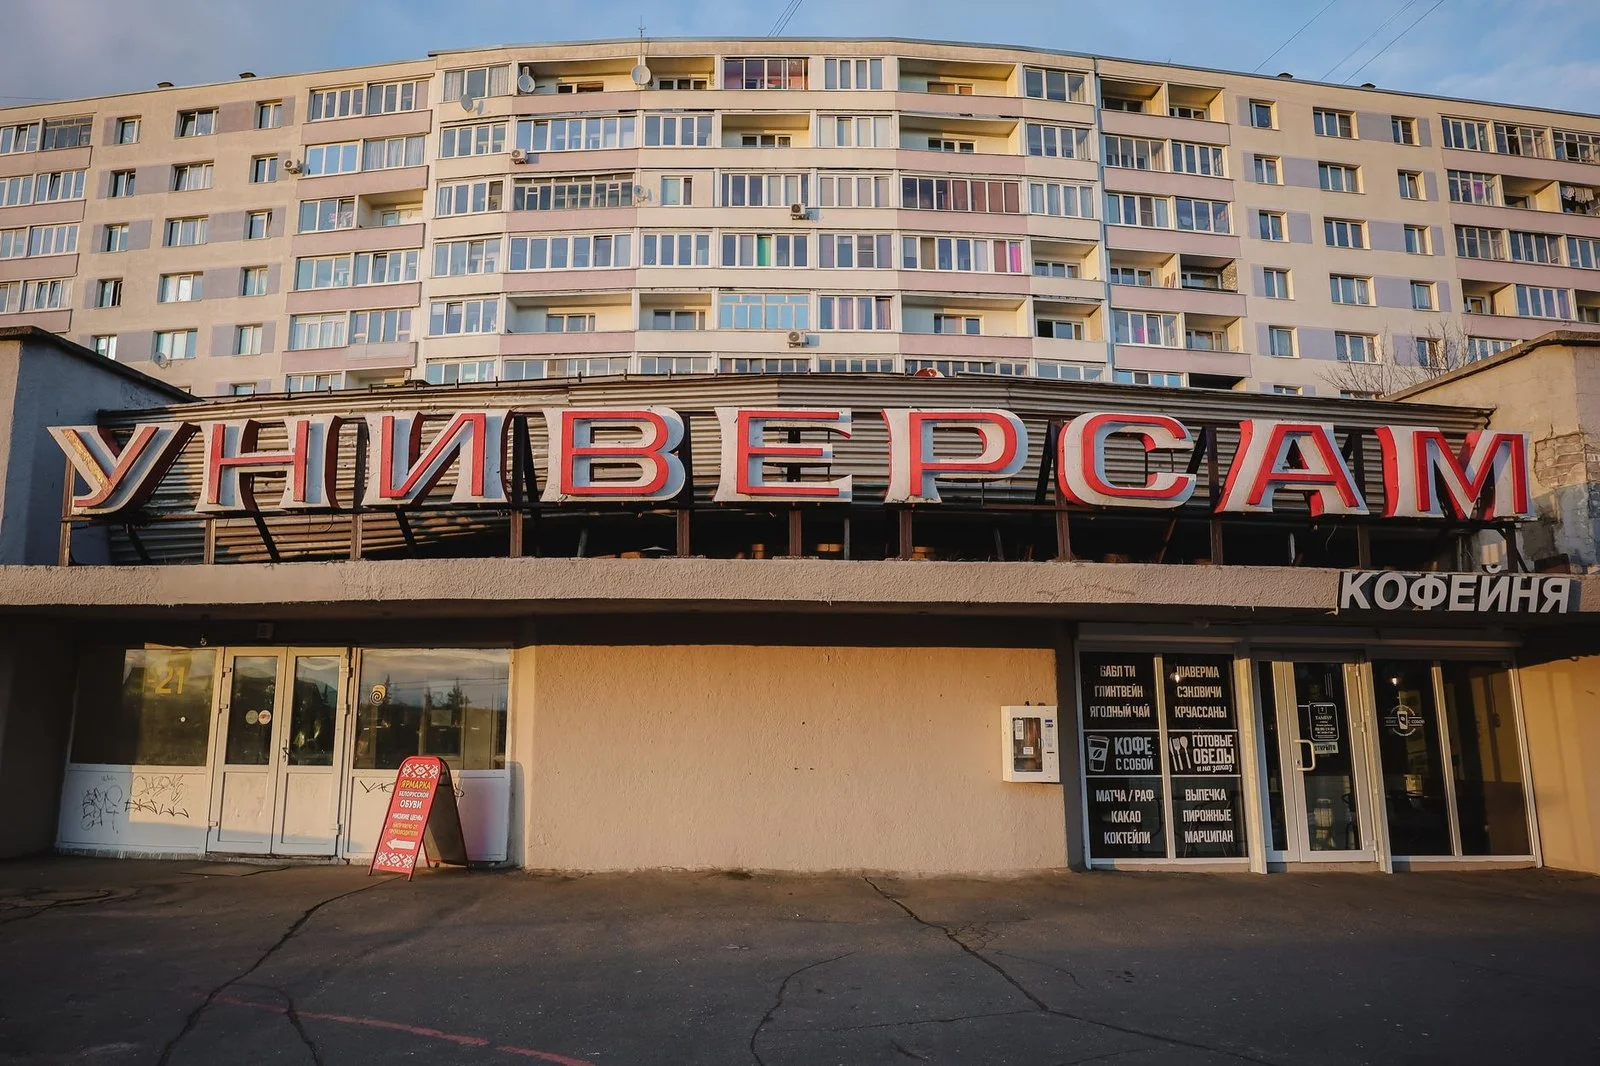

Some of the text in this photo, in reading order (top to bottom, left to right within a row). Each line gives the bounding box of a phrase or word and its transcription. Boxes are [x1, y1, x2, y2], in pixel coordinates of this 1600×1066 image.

[47, 406, 1536, 520] УНИВЕРСАМ
[1340, 564, 1571, 614] КОФЕЙНЯ
[1100, 665, 1136, 677] БАБЛ ТИ
[1176, 666, 1220, 678] ШАВЕРМА
[1094, 683, 1143, 698] ГЛИНТВЕЙН
[1177, 686, 1222, 698] СЭНДВИЧИ
[1090, 703, 1150, 718] ЯГОДНЫЙ ЧАЙ
[1174, 706, 1227, 718] КРУАССАНЫ
[1114, 736, 1152, 755] КОФЕ
[1192, 734, 1233, 748] ГОТОВЫЕ
[1115, 755, 1154, 771] С СОБОЙ
[1193, 748, 1235, 765] ОБЕДЫ
[400, 780, 431, 790] ЯРМАРКА
[1096, 789, 1127, 802] МАТЧА
[1135, 789, 1154, 802] РАФ
[1185, 788, 1227, 801] ВЫПЕЧКА
[400, 800, 422, 808] ОБУВИ
[1111, 810, 1141, 823] КАКАО
[1183, 809, 1232, 822] ПИРОЖНЫЕ
[1104, 828, 1151, 844] КОКТЕЙЛИ
[1184, 830, 1234, 844] МАРЦИПАН
